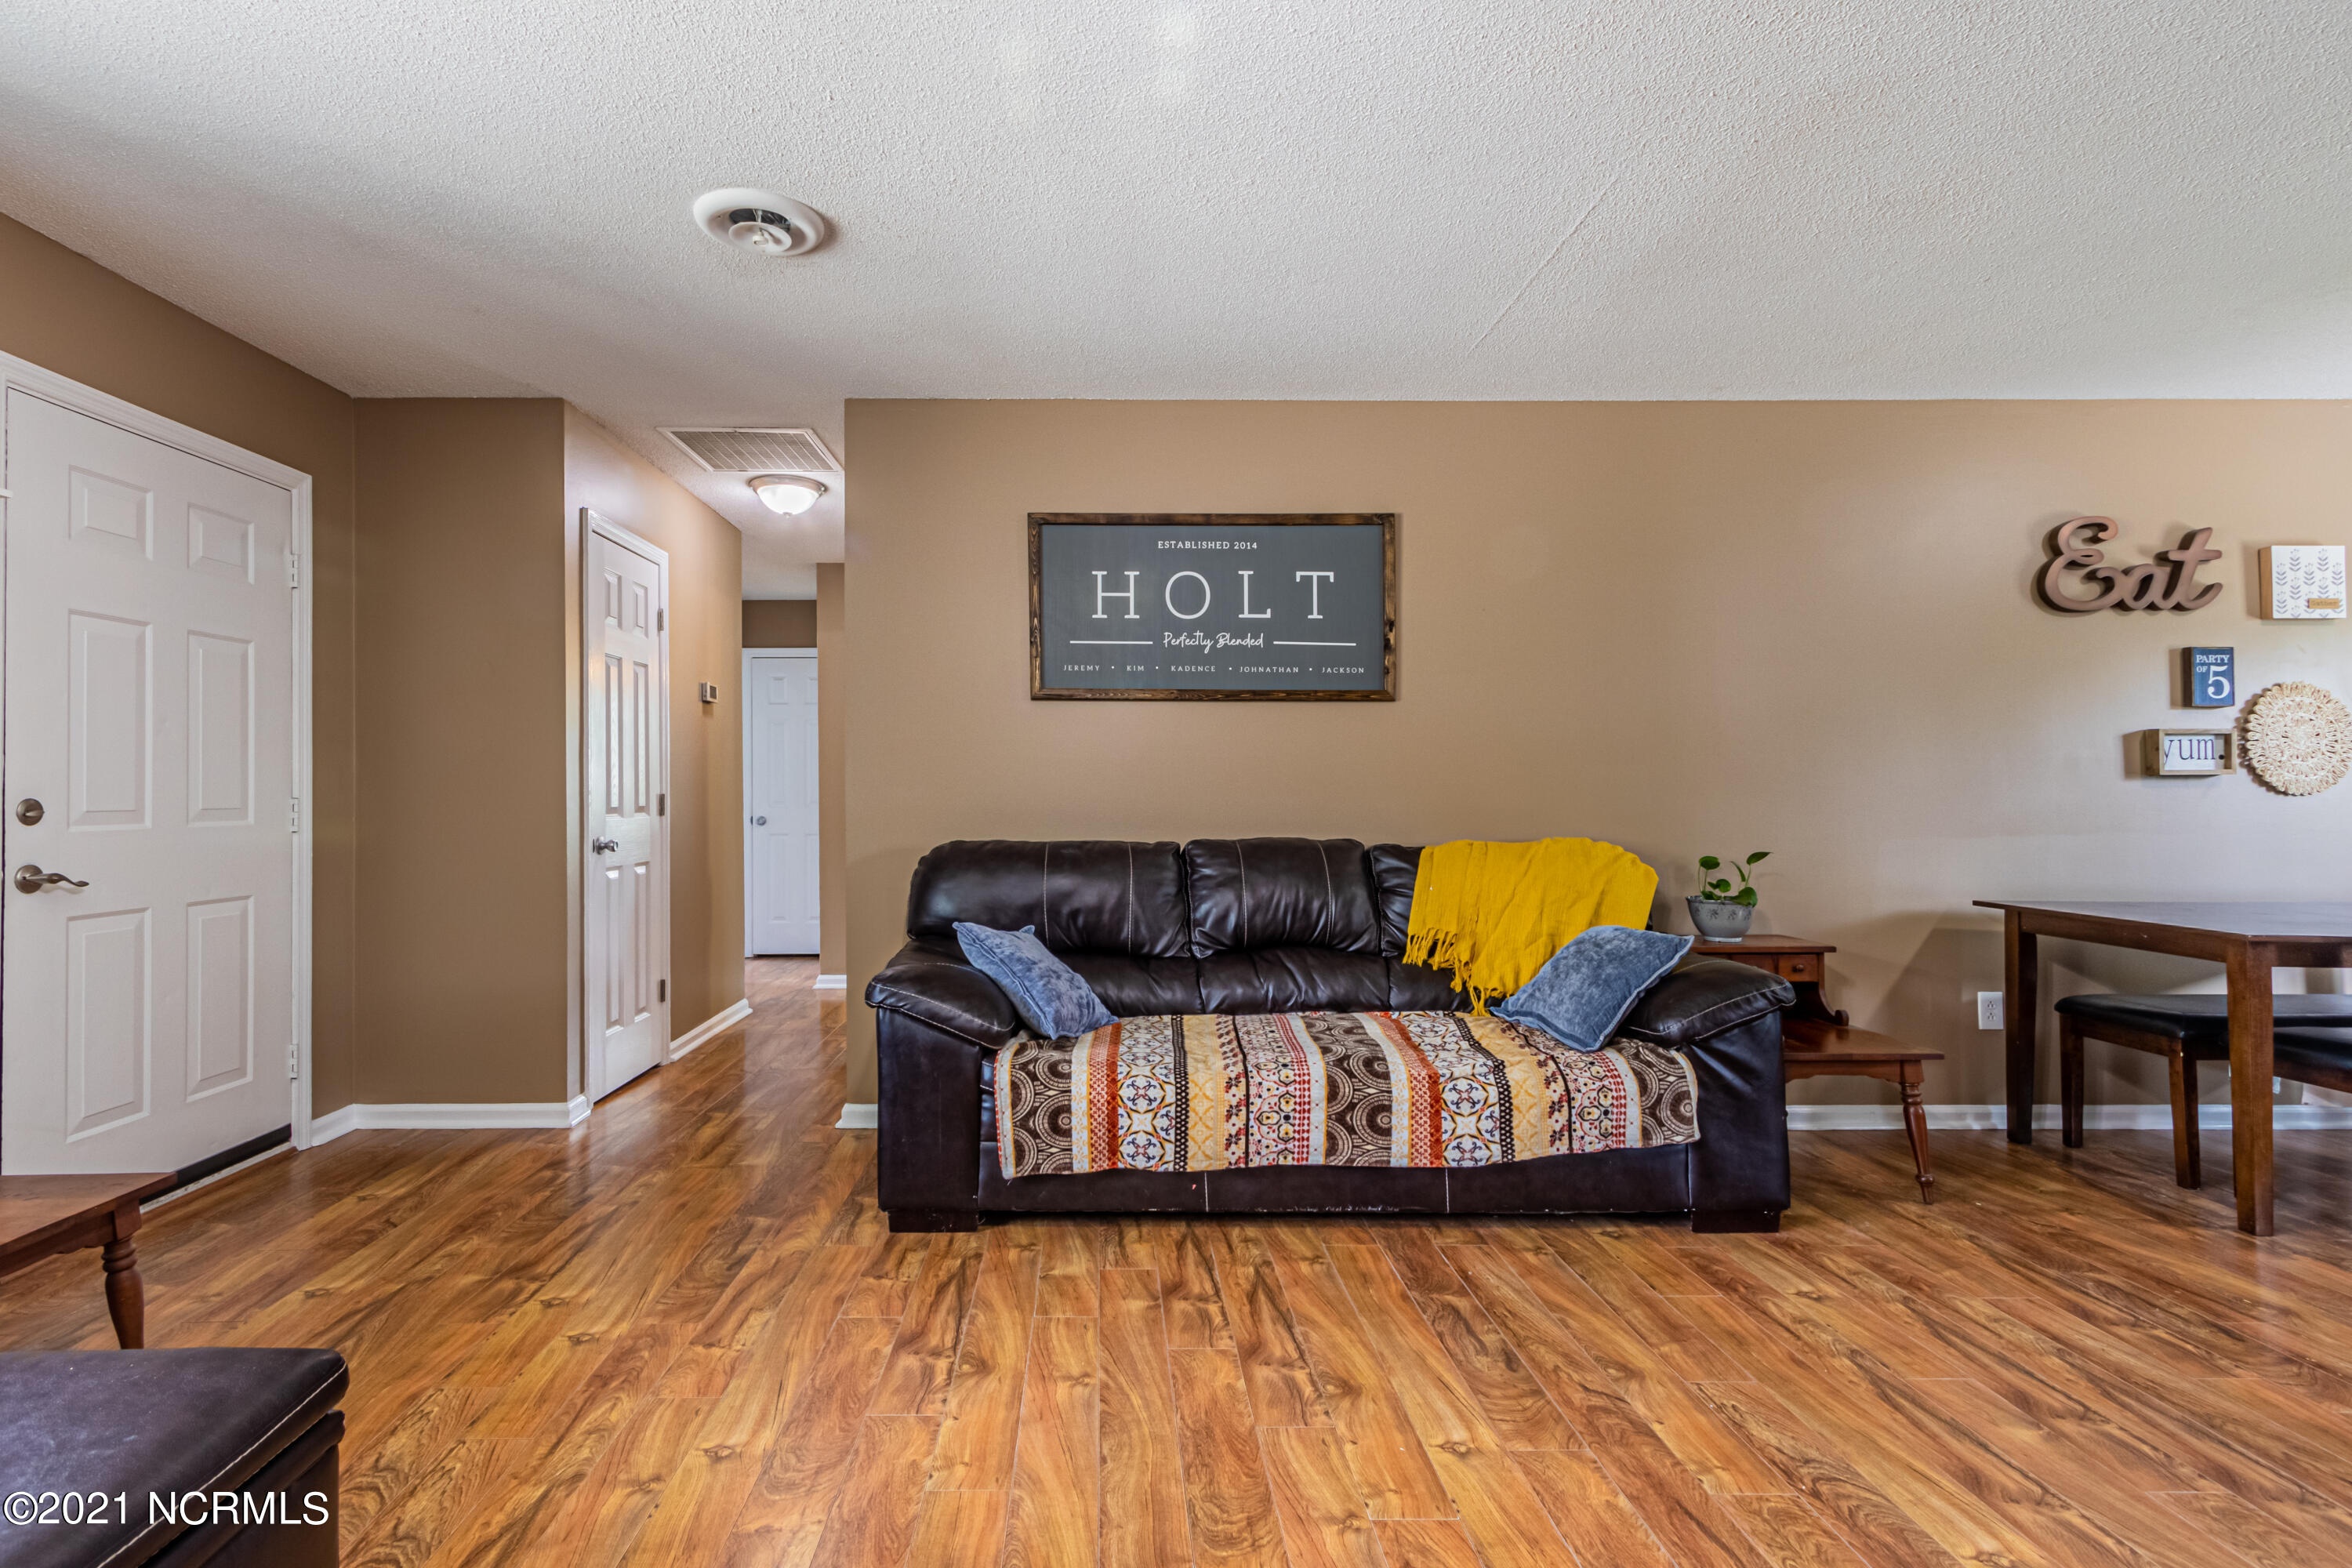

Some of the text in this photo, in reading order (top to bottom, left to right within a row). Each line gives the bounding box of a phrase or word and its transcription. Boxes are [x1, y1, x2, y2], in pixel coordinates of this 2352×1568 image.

[1157, 540, 1258, 550] ESTABLISHED 2014
[2038, 516, 2223, 612] Eat
[1092, 570, 1334, 619] HOLT
[1163, 630, 1264, 654] Perfectly Blended
[1239, 666, 1300, 674] JOHNATHAN
[2195, 654, 2230, 664] PARTY
[2207, 665, 2230, 699] 5
